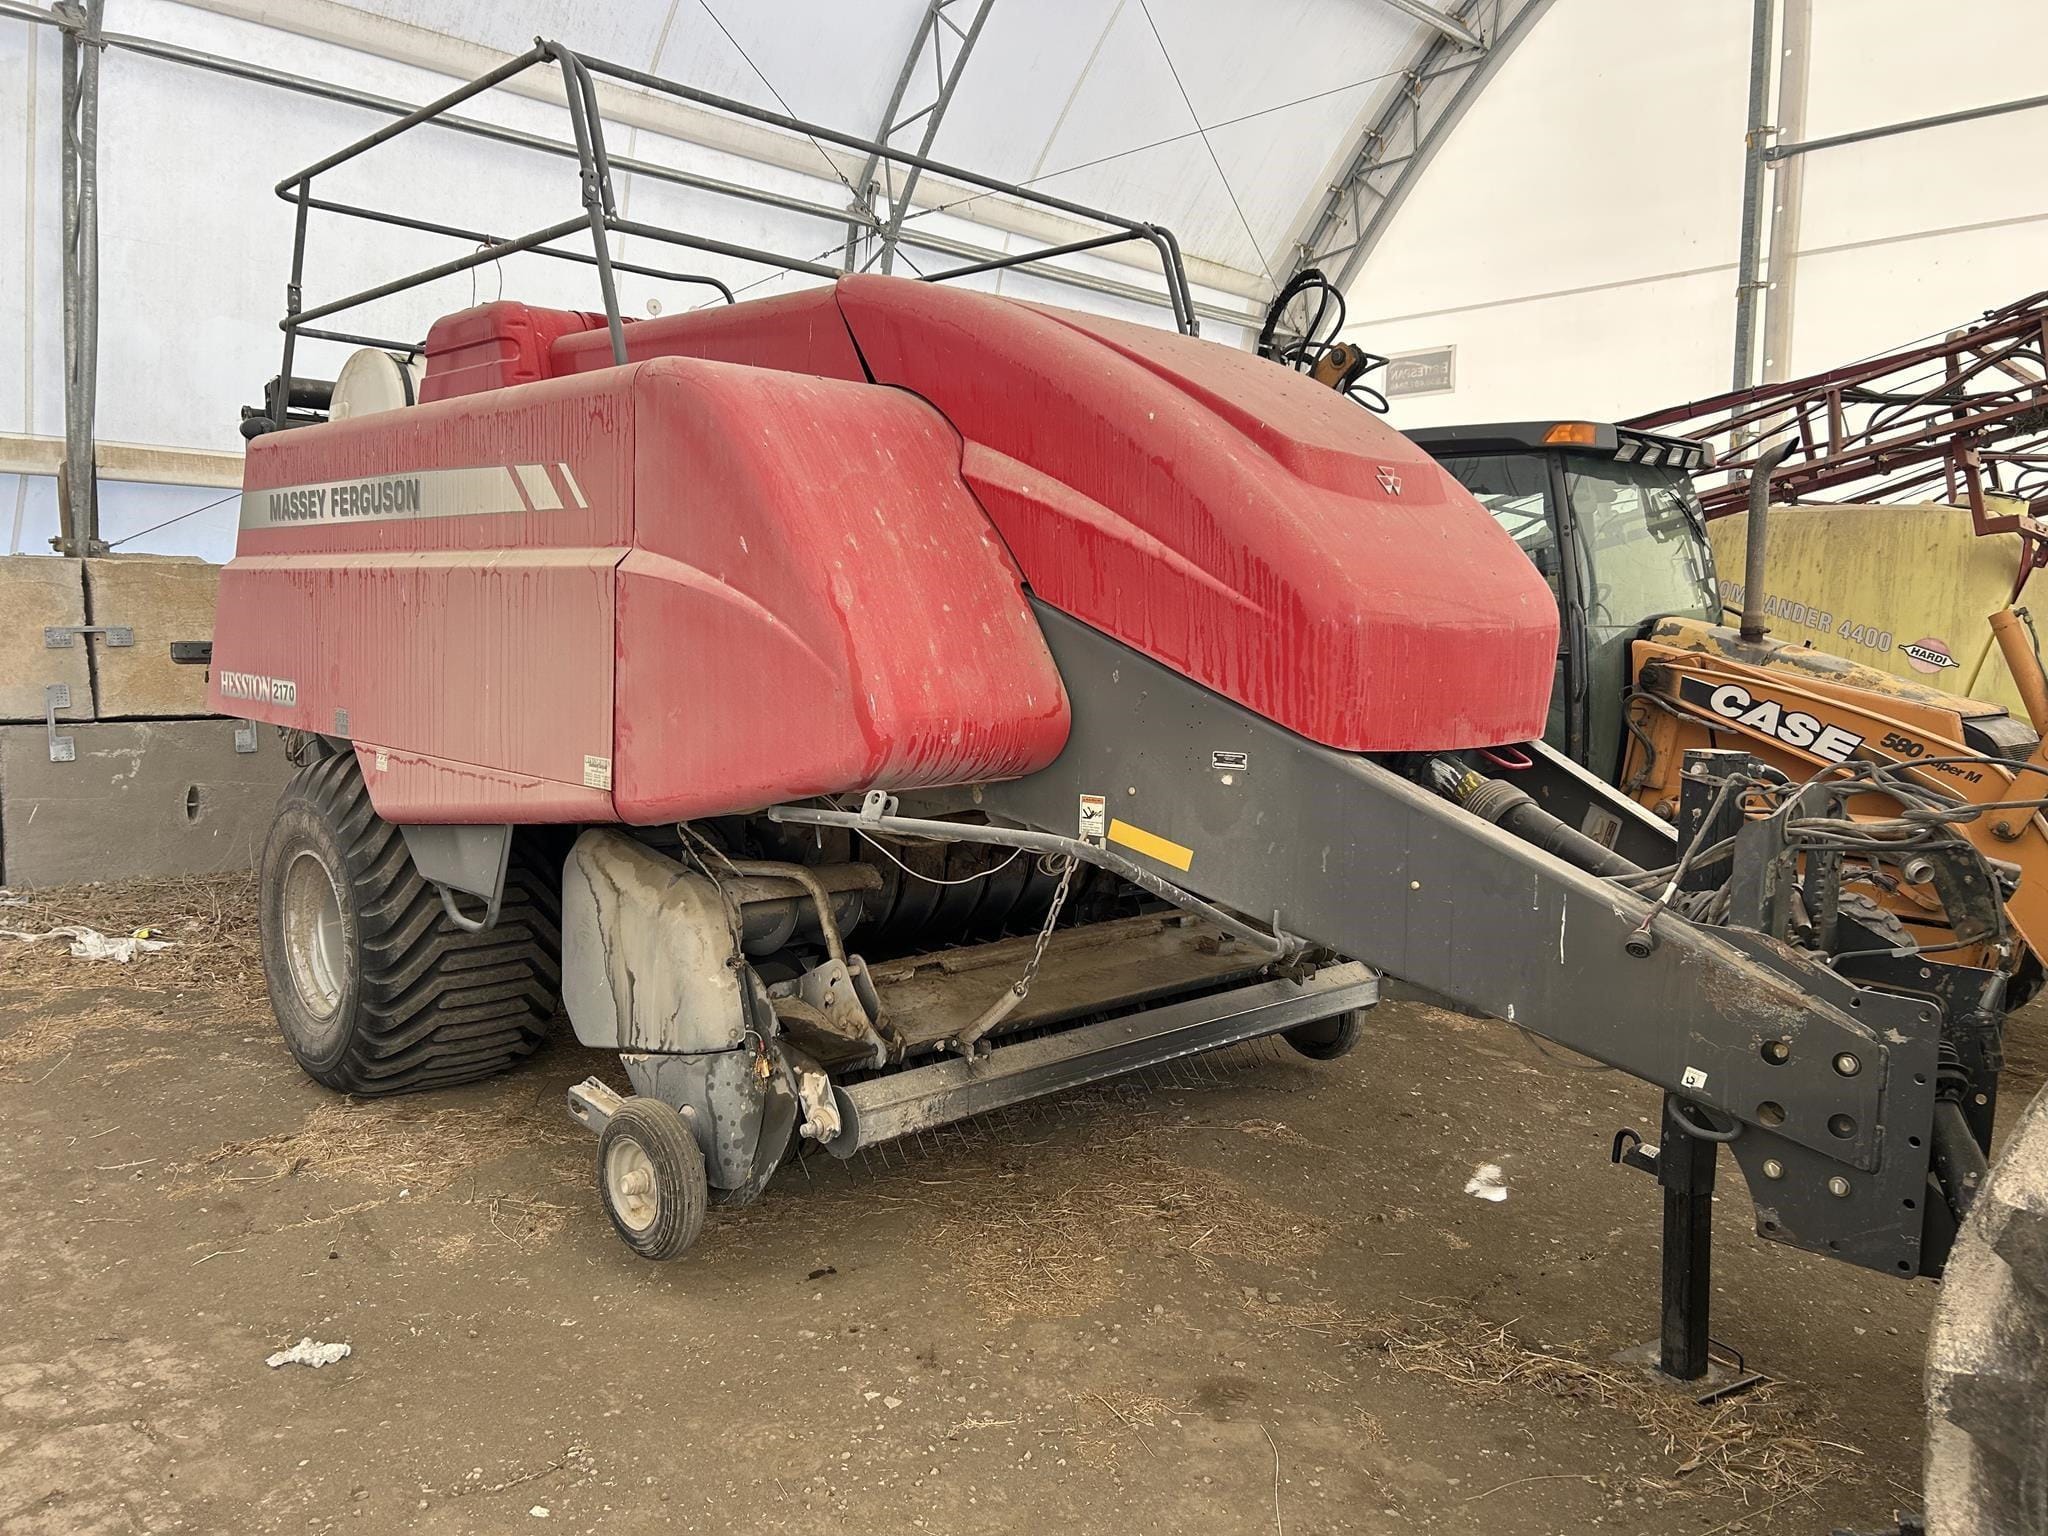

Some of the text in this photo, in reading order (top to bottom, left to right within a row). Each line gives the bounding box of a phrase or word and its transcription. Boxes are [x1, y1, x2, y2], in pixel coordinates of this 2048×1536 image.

[269, 478, 421, 522] MASSEY FERGUSON
[1719, 580, 1893, 652] OMANDER 4400
[1910, 646, 1948, 665] HARDI
[220, 670, 295, 702] HESSTON 2170
[1709, 683, 1864, 762] CASE
[1880, 732, 1925, 757] 580
[1964, 770, 1983, 783] M
